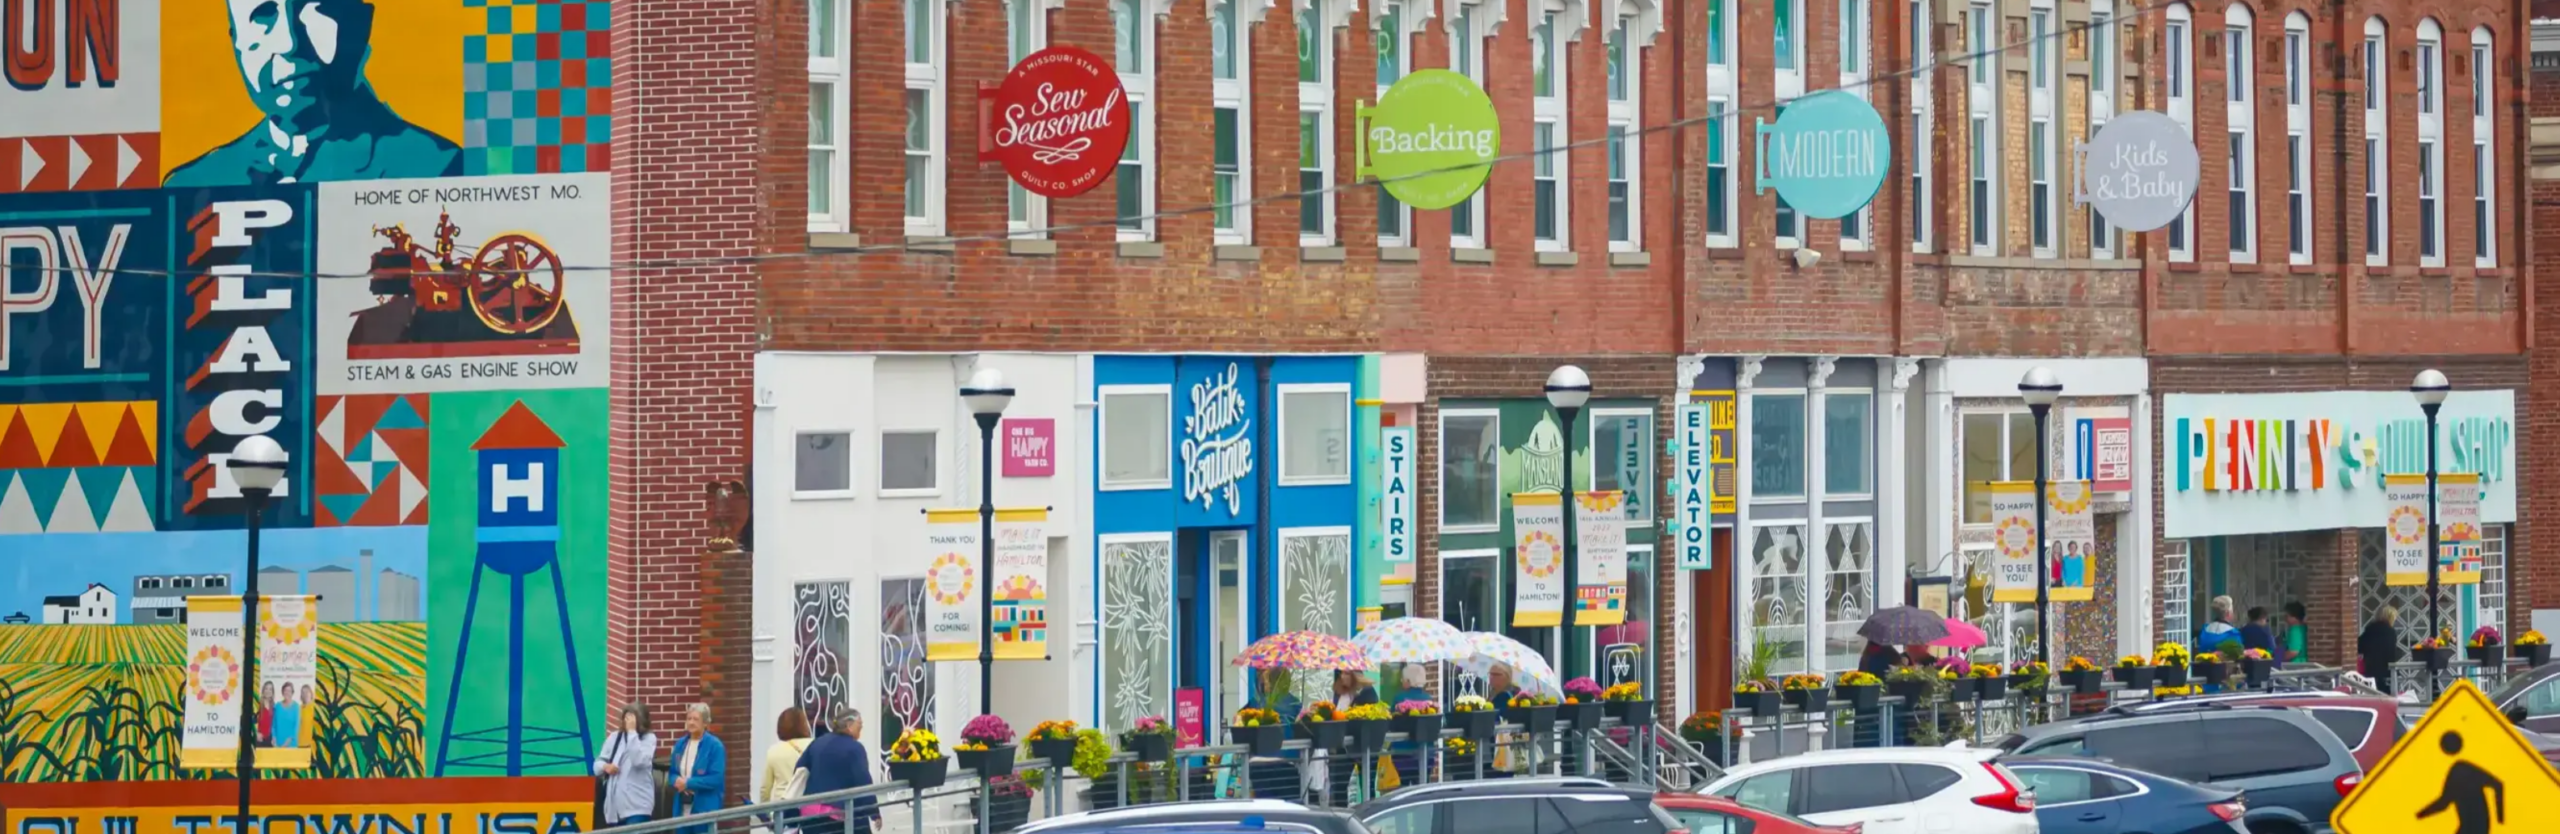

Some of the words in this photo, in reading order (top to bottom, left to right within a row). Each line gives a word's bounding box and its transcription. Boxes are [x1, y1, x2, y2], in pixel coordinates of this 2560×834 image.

[1026, 54, 1073, 71] MISSOURI
[1076, 58, 1099, 77] STAR
[1031, 82, 1088, 117] Sew
[995, 88, 1120, 147] Seasonal
[1370, 123, 1494, 157] Backing
[1780, 129, 1875, 179] MODERN
[2110, 139, 2168, 173] Kids
[1021, 170, 1048, 188] QUILT
[1072, 167, 1097, 187] SHOP
[355, 190, 402, 205] HOME
[408, 189, 429, 204] OF
[436, 186, 540, 203] NORTHWEST
[551, 184, 582, 200] MO.
[2120, 171, 2182, 208] Baby
[347, 365, 399, 381] STEAM
[405, 364, 415, 379] &
[421, 364, 452, 379] GAS
[461, 362, 518, 377] ENGINE
[527, 361, 578, 376] SHOW
[1192, 362, 1241, 441] Batik
[1011, 437, 1049, 457] HAPPY
[2177, 417, 2364, 492] PENNEY'S
[1181, 427, 1252, 517] Boutique
[492, 462, 544, 512] H
[1389, 436, 1405, 556] STAIRS
[1686, 411, 1702, 562] ELEVATOR
[1994, 503, 2005, 511] SO
[2008, 502, 2034, 512] HAPPY
[2401, 493, 2425, 501] HAPPY
[1516, 516, 1559, 525] WELCOME
[930, 536, 957, 544] THANK
[959, 536, 975, 544] YOU
[2392, 550, 2405, 558] TO
[2406, 549, 2423, 557] SEE
[2397, 558, 2418, 566] YOU!
[2001, 564, 2013, 573] TO
[2016, 563, 2033, 572] SEE
[2006, 573, 2028, 582] YOU!
[1519, 593, 1560, 601] HAMILTON!
[943, 612, 960, 620] FOR
[190, 628, 239, 637] WELCOME
[934, 624, 970, 632] COMING!
[207, 712, 219, 721] TO
[187, 725, 236, 735] HAMILTON!
